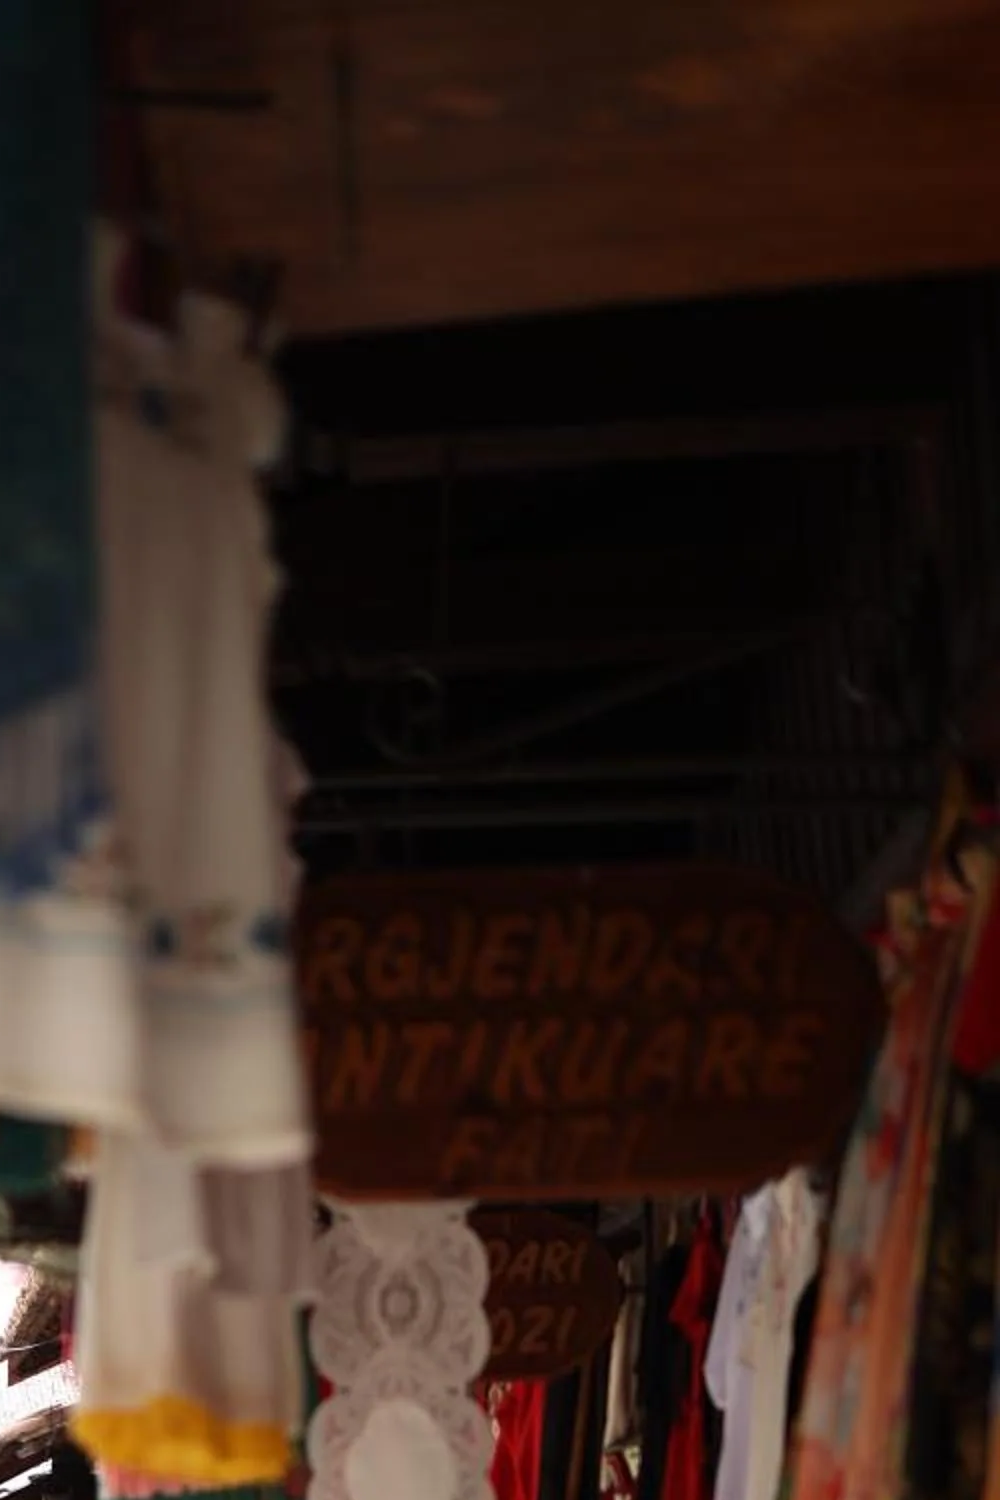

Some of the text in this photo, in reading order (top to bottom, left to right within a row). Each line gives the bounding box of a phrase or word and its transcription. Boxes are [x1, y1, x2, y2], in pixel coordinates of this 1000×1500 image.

[304, 906, 808, 1001] RGJENDARI
[304, 1012, 825, 1109] NTIKUARE
[487, 1238, 589, 1284] DARI
